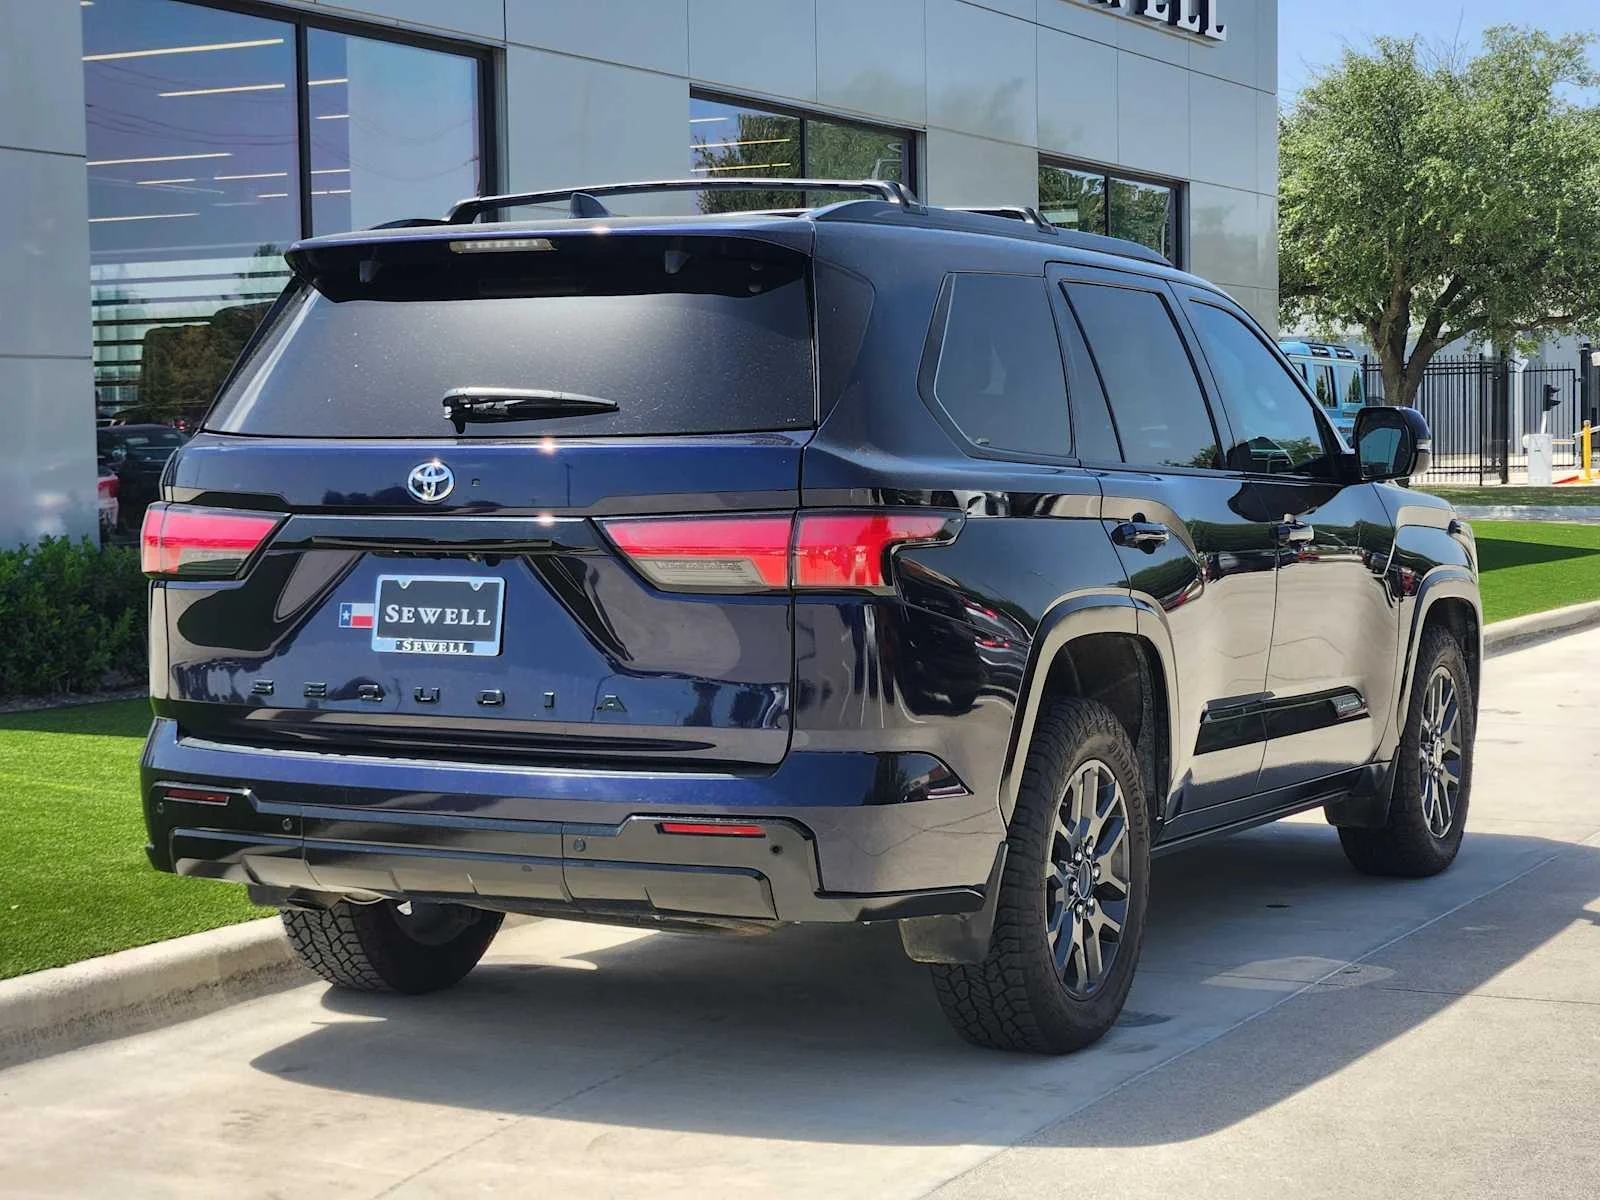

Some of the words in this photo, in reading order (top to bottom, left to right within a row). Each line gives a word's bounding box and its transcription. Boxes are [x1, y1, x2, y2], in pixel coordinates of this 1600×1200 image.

[385, 604, 491, 626] SEWELL
[401, 638, 468, 654] SEWELL
[251, 679, 628, 713] SEQUOIA
